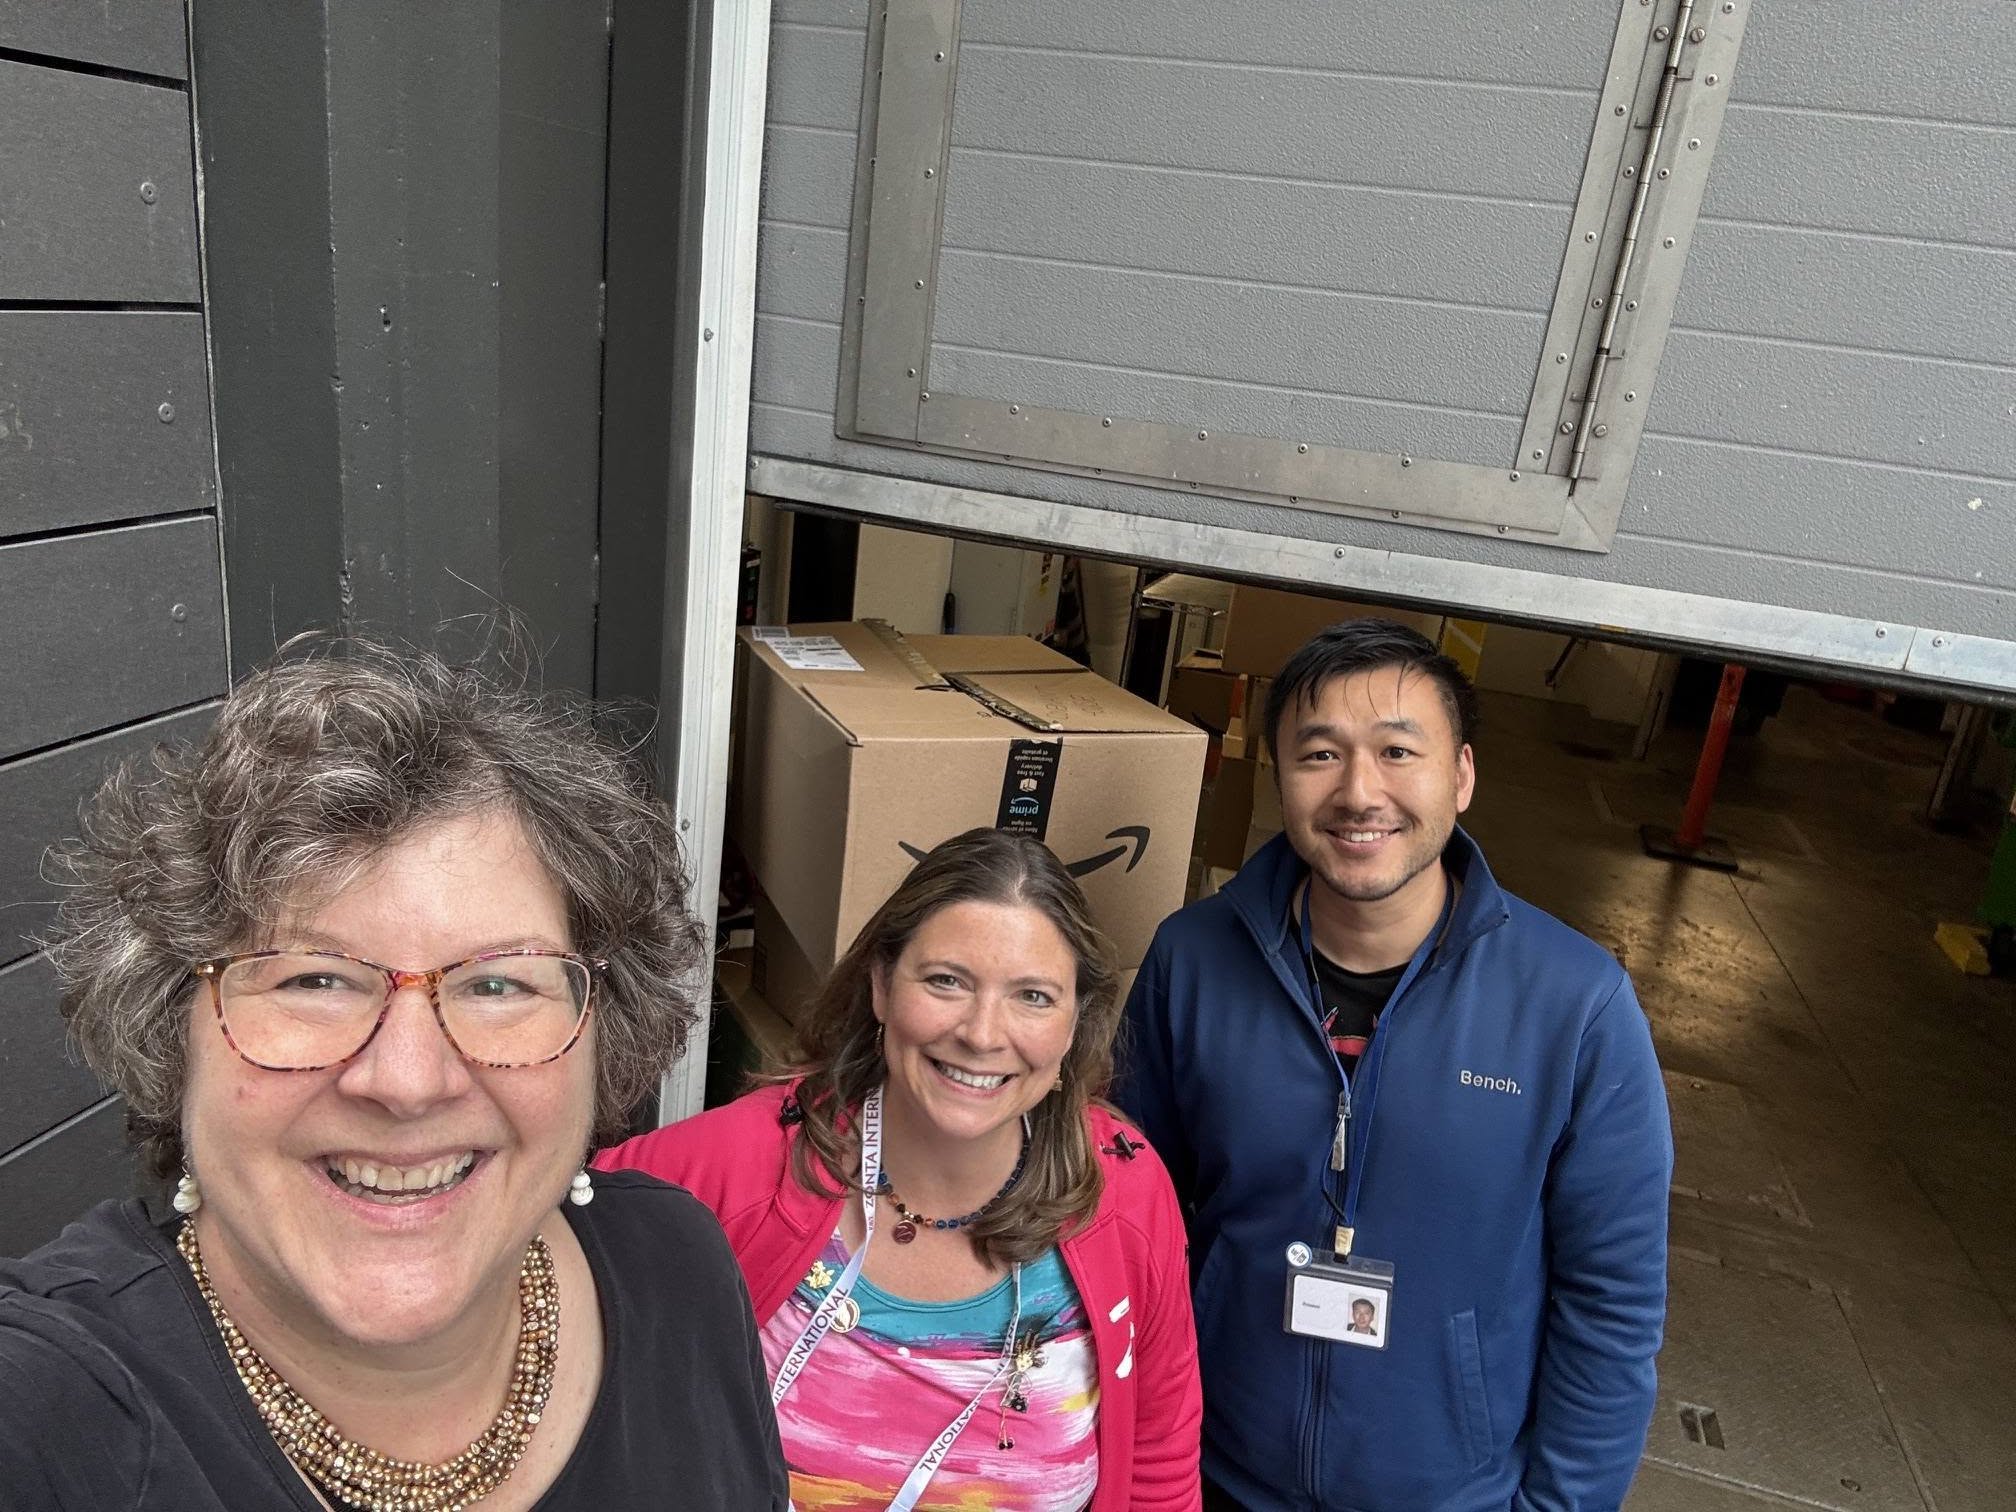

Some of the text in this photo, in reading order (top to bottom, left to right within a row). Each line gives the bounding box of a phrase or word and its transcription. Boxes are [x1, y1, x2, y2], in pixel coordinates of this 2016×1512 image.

[1009, 805, 1039, 816] prime
[1460, 1069, 1522, 1095] Bench.
[865, 1088, 880, 1148] INTERN
[865, 1151, 878, 1208] ZONTA
[774, 1287, 849, 1401] INTERNATIONAL
